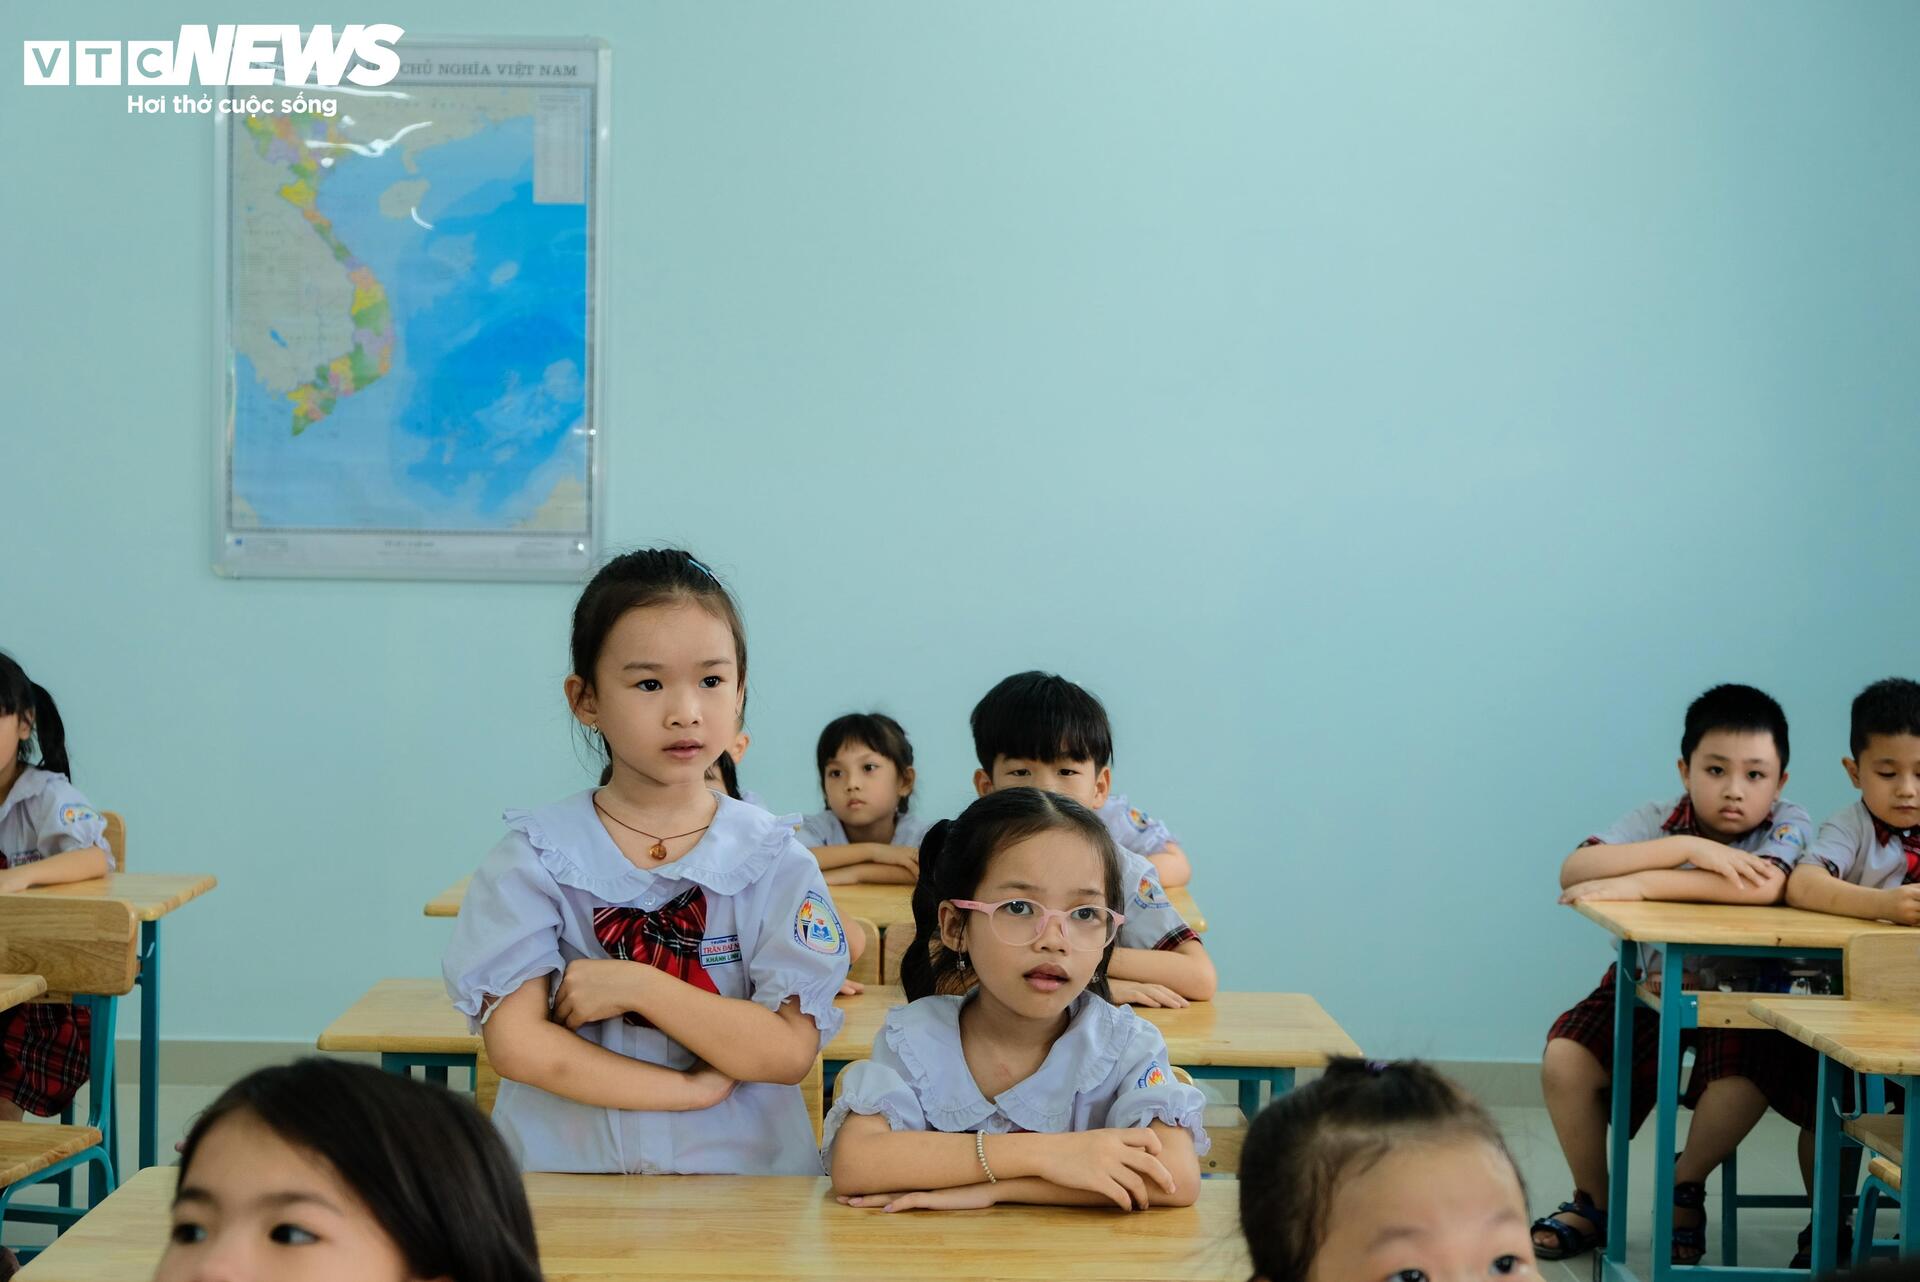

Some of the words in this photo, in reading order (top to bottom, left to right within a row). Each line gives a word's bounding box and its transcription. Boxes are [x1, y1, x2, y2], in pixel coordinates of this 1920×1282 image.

[438, 61, 491, 75] NGHĨA
[496, 61, 534, 77] VIỆT
[539, 64, 577, 76] NAM
